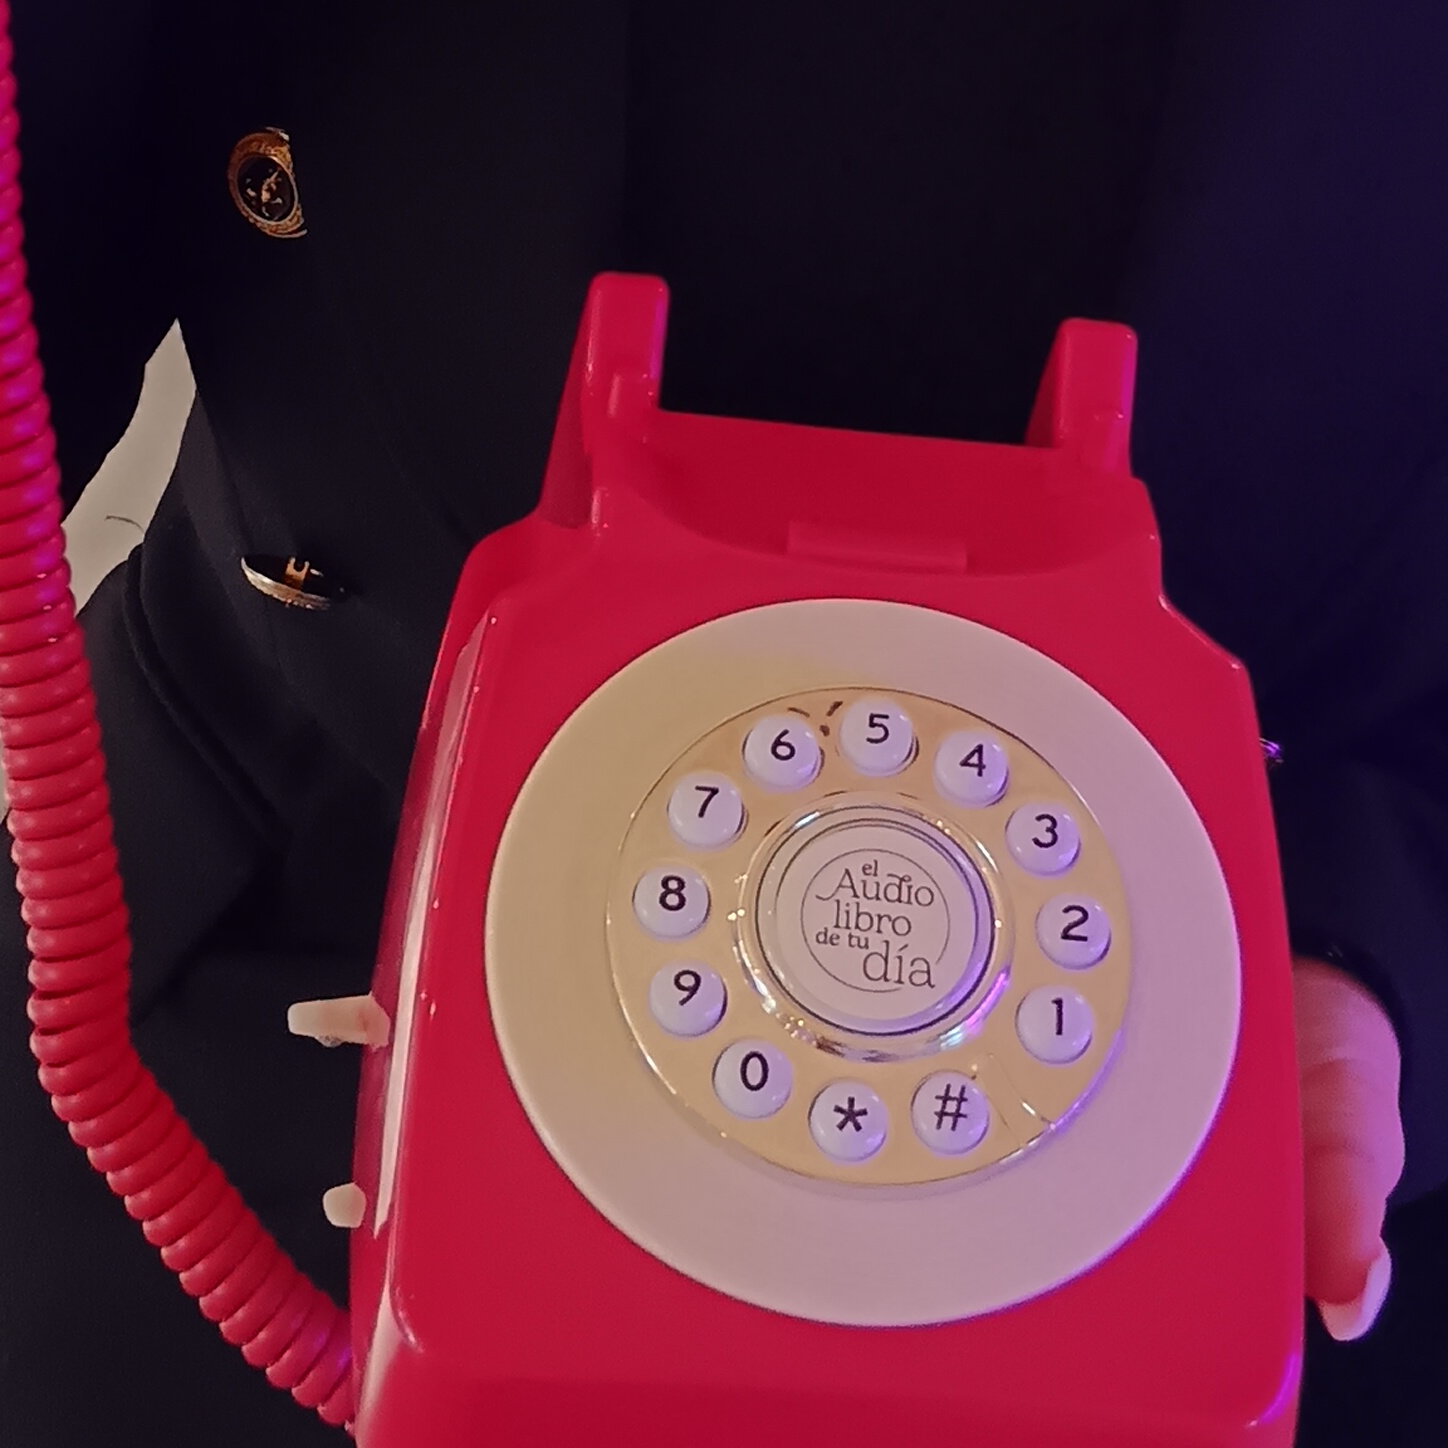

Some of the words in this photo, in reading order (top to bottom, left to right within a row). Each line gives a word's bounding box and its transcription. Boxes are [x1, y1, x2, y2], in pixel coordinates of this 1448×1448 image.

[770, 729, 796, 761] 6
[866, 713, 889, 744] 5
[959, 743, 986, 777] 4
[695, 785, 719, 818] 7
[1031, 814, 1059, 848] 3
[862, 859, 878, 877] el
[658, 875, 686, 911] 8
[815, 868, 935, 907] Audio
[833, 898, 912, 937] libro
[1060, 904, 1089, 942] 2
[815, 926, 840, 947] de
[848, 931, 869, 950] tu
[862, 939, 936, 989] día
[673, 969, 701, 1006] 9
[1052, 997, 1063, 1036] 1
[740, 1051, 769, 1092] 0
[934, 1084, 968, 1131] #
